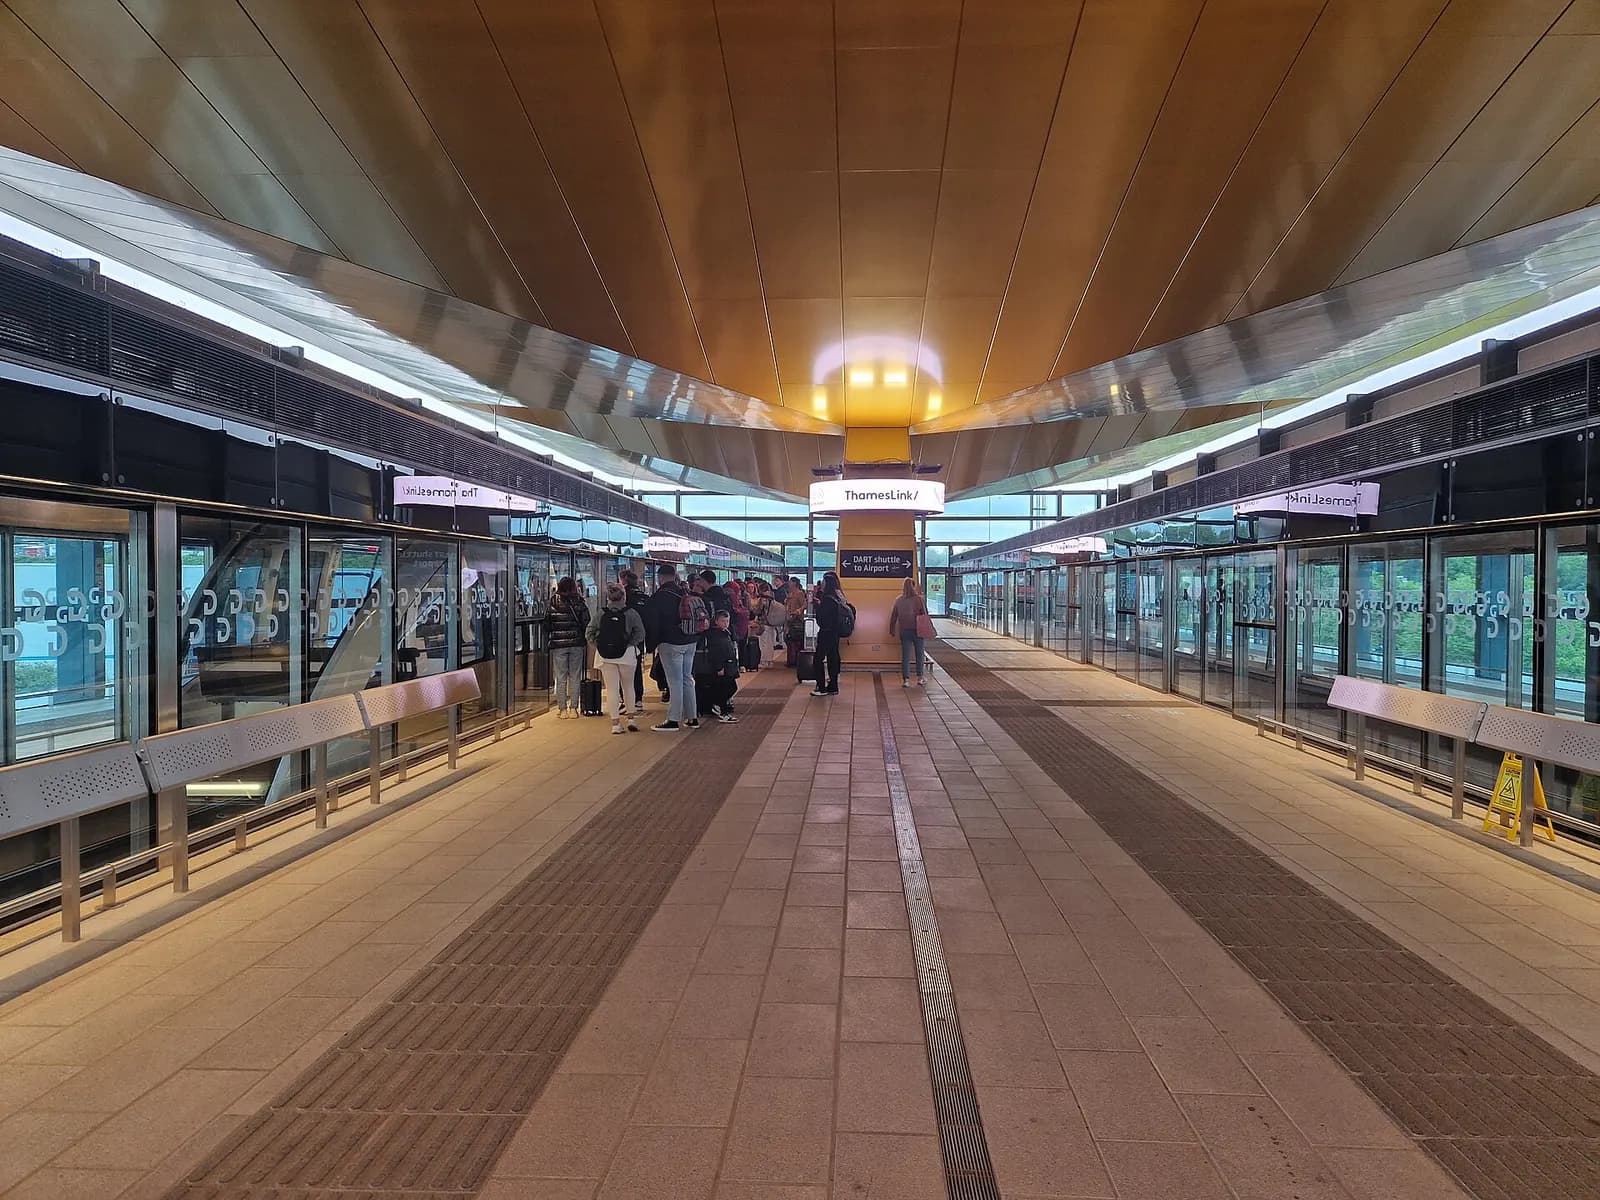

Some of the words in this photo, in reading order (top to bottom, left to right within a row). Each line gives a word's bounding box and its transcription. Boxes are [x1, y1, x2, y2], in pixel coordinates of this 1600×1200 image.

[845, 490, 919, 501] ThamesLink/
[853, 555, 872, 563] DART
[874, 555, 901, 564] shuttle
[854, 564, 862, 572] to
[863, 564, 889, 574] Airport
